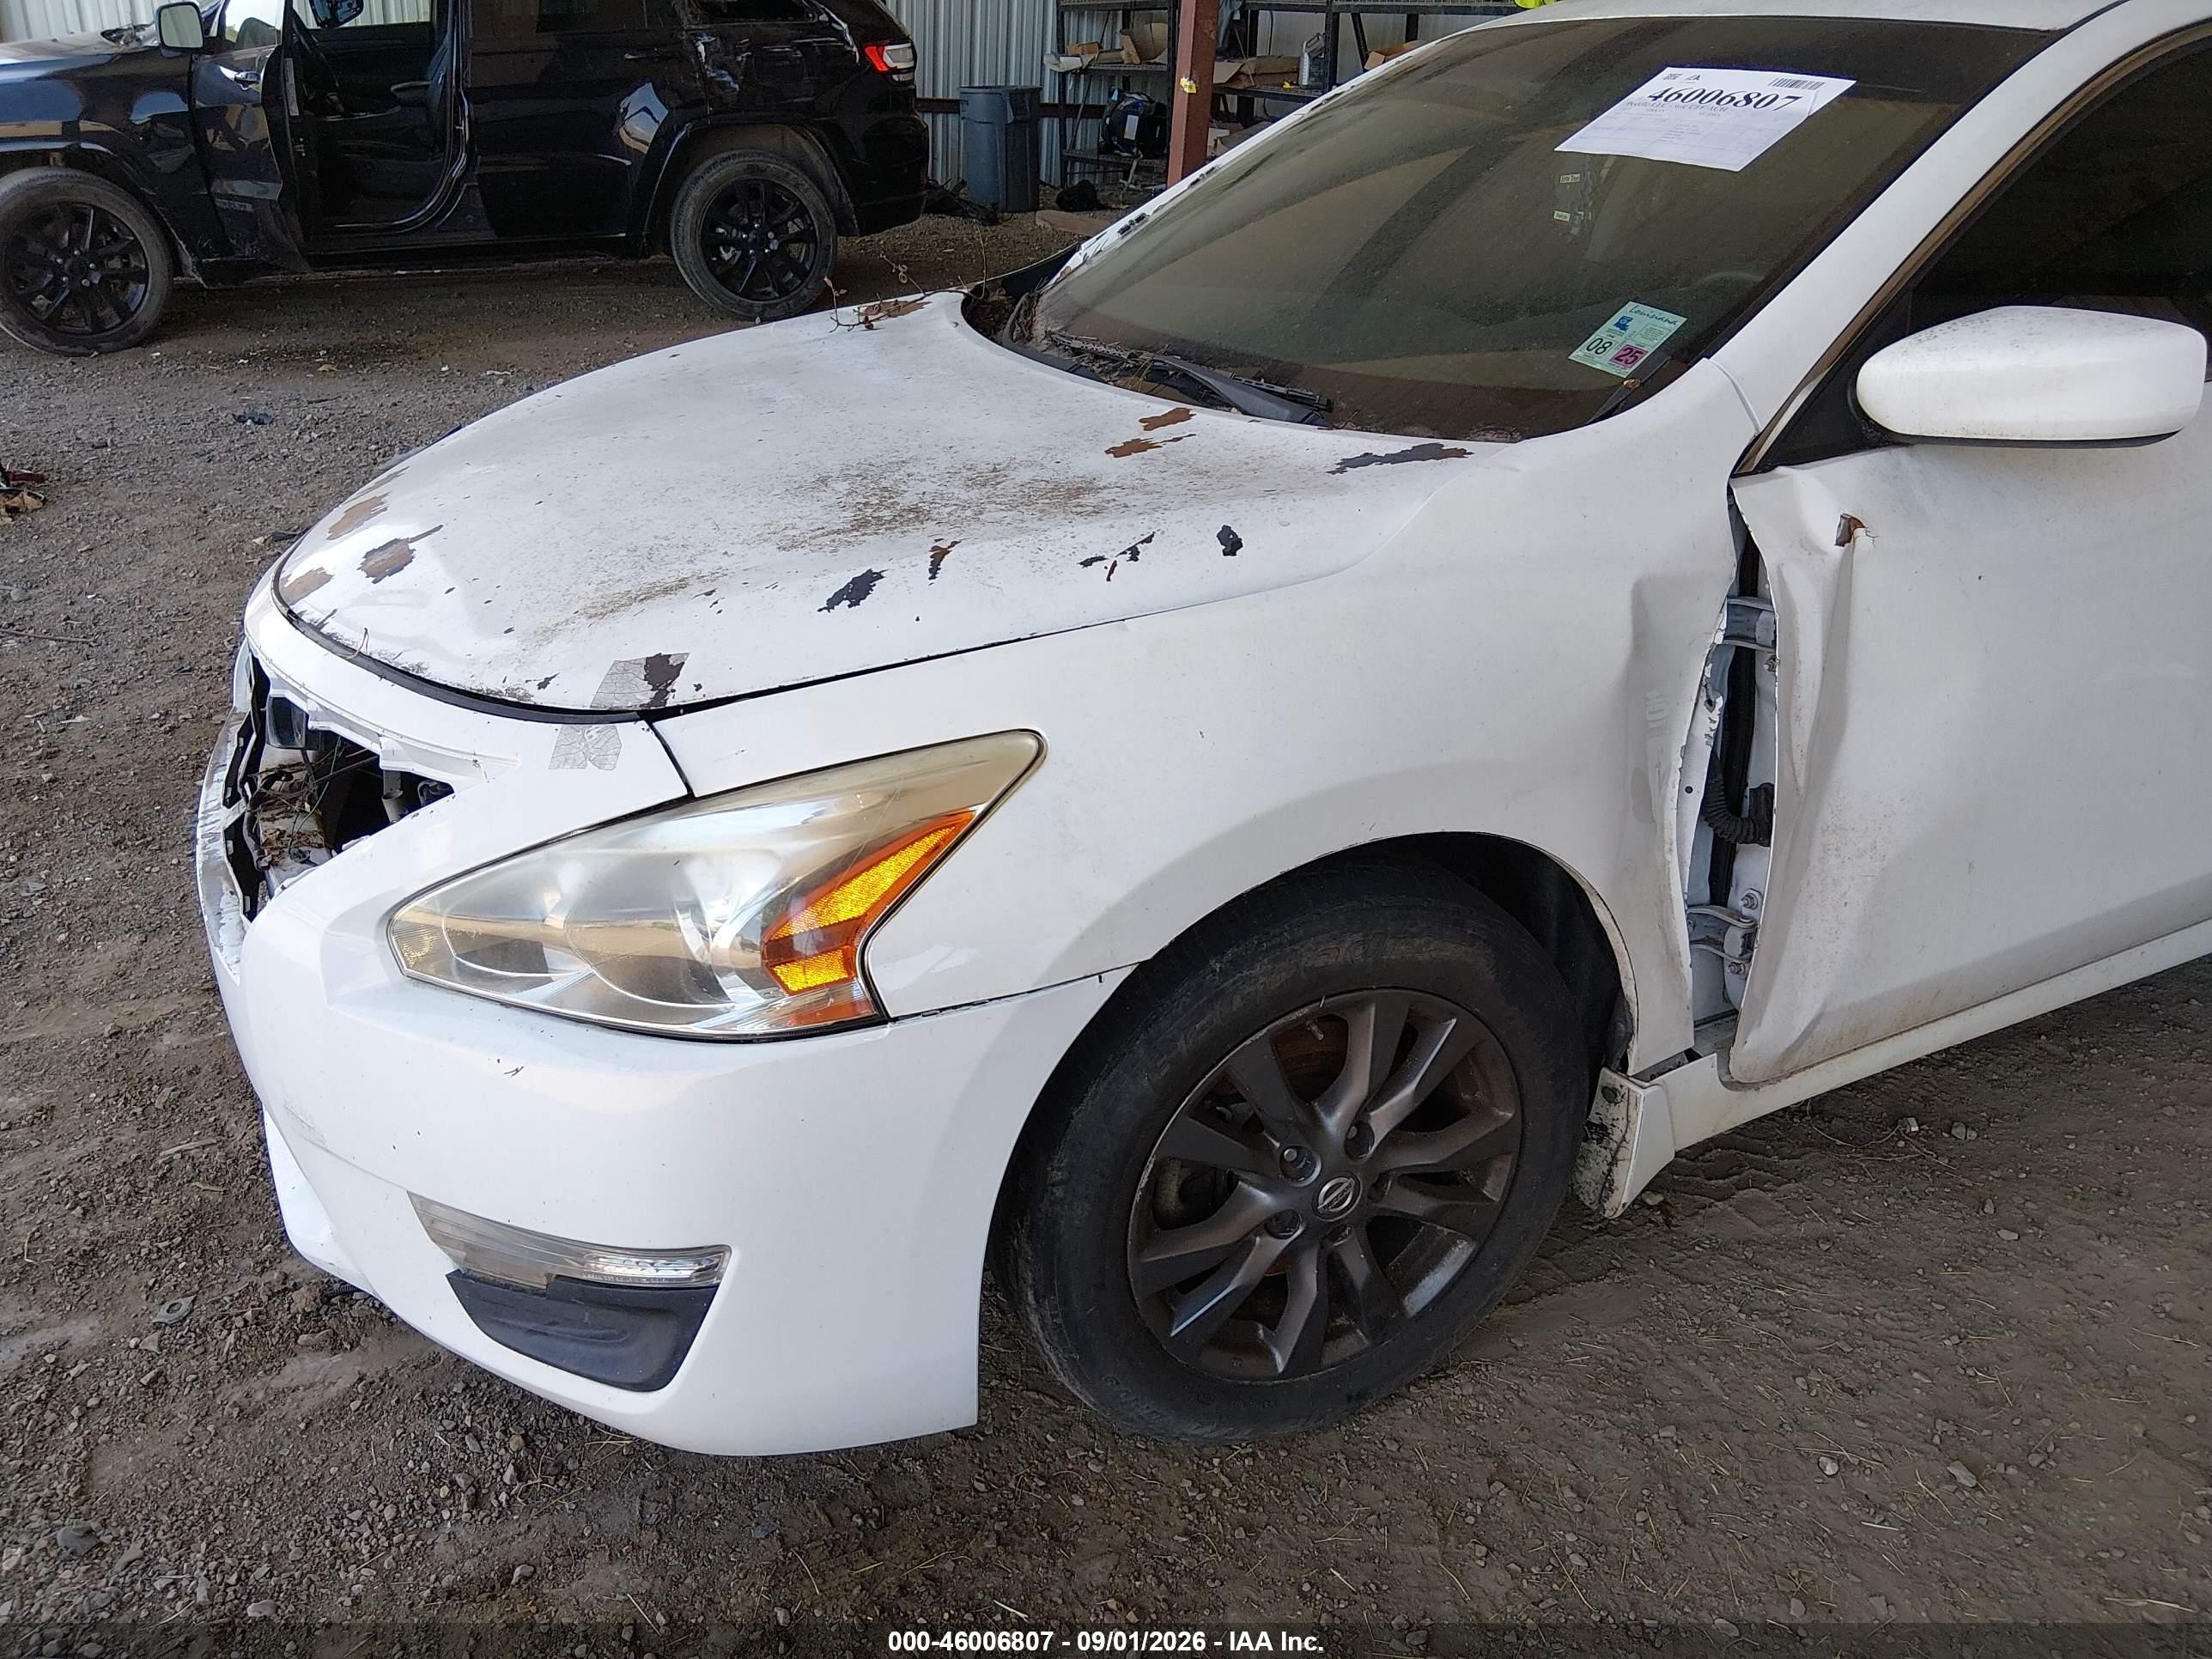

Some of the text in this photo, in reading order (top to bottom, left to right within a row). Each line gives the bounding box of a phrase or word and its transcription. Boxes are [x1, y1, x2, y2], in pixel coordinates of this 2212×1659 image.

[1648, 87, 1802, 112] 46006807
[1628, 305, 1678, 325] Louisiana
[1586, 337, 1613, 355] 08
[1613, 345, 1644, 366] 25
